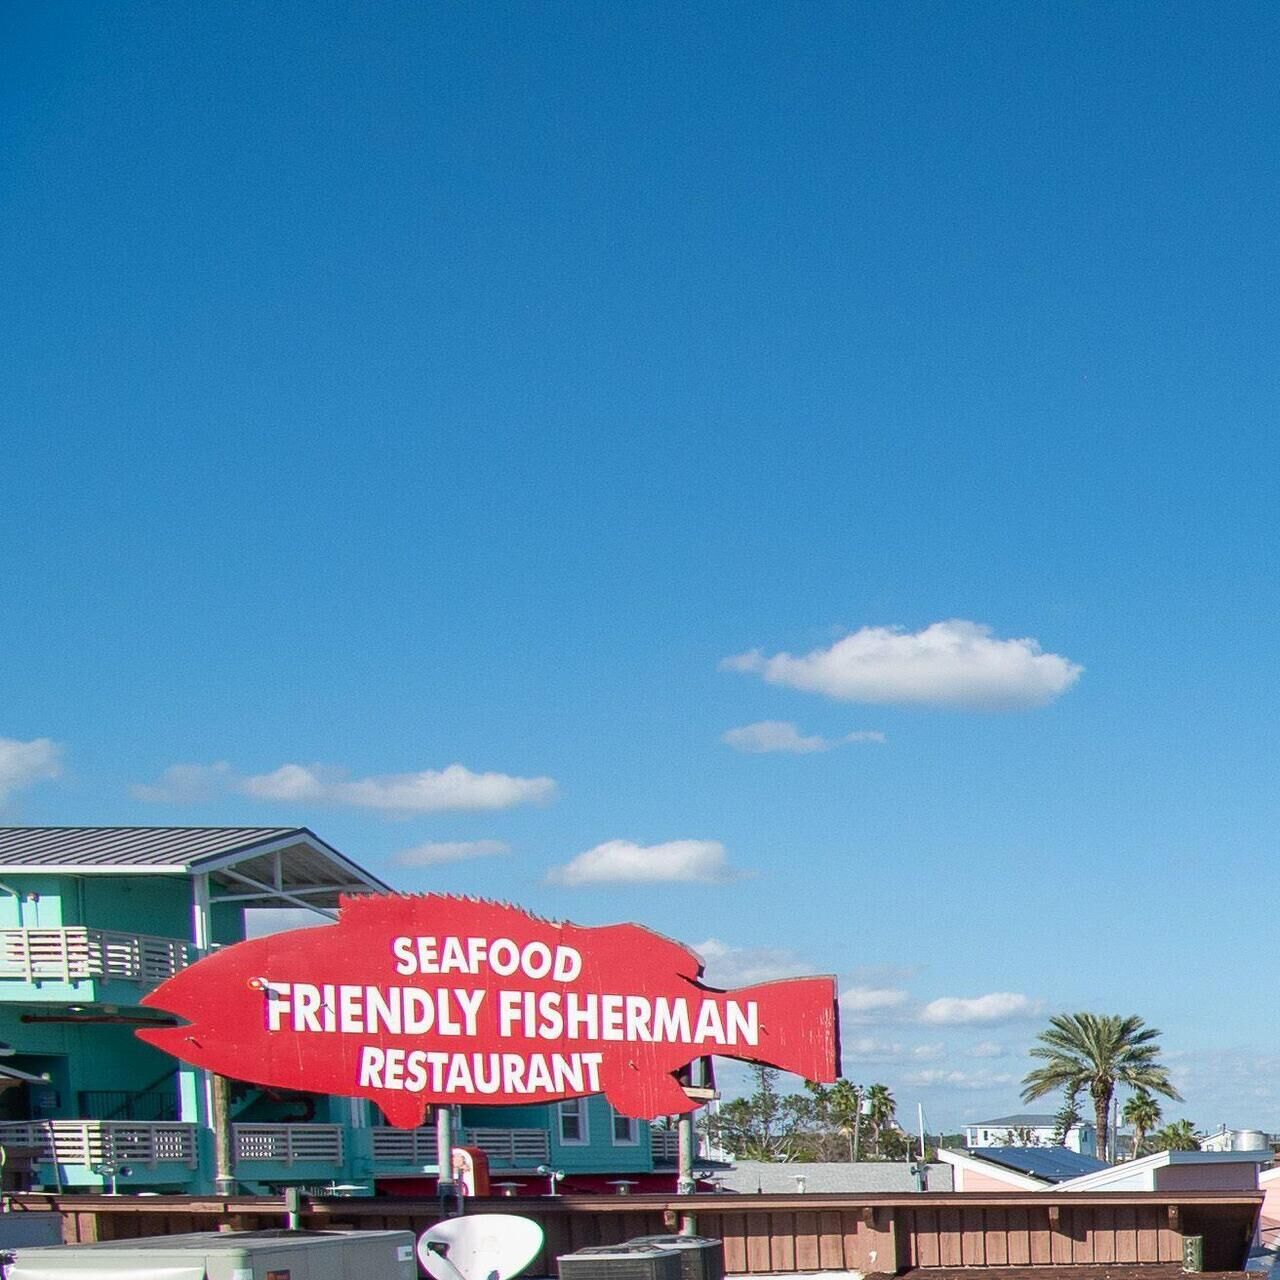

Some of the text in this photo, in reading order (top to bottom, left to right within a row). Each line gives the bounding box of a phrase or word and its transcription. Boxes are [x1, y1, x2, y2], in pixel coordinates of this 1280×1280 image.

[393, 936, 583, 983] SEAFOOD
[267, 981, 758, 1046] FRIENDLY FISHERMAN
[359, 1046, 604, 1094] RESTAURANT
